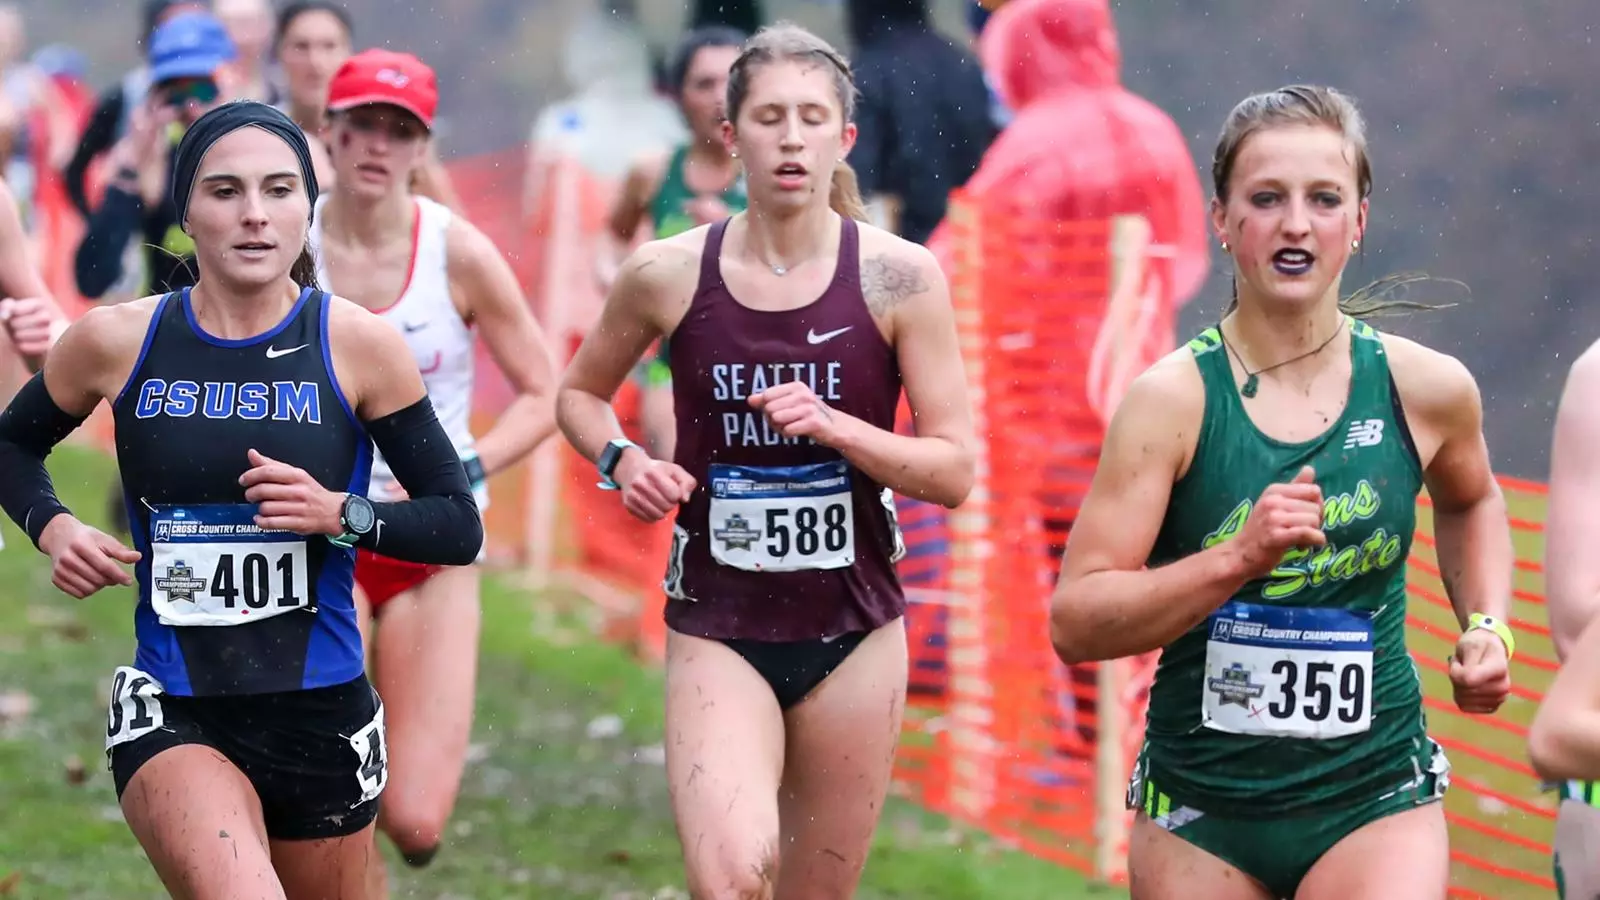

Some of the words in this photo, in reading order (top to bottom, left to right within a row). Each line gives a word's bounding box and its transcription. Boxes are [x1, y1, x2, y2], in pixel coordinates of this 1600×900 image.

[135, 378, 322, 425] CSUSM
[712, 362, 842, 401] SEATTLE
[171, 524, 198, 534] CROSS
[198, 524, 235, 534] COUNTRY
[764, 503, 847, 558] 588
[210, 552, 300, 609] 401
[1261, 527, 1400, 600] State
[1232, 624, 1261, 637] CROSS
[1261, 628, 1302, 640] COUNTRY
[1302, 630, 1369, 642] CHAMPIONSHIPS
[1268, 660, 1365, 723] 359
